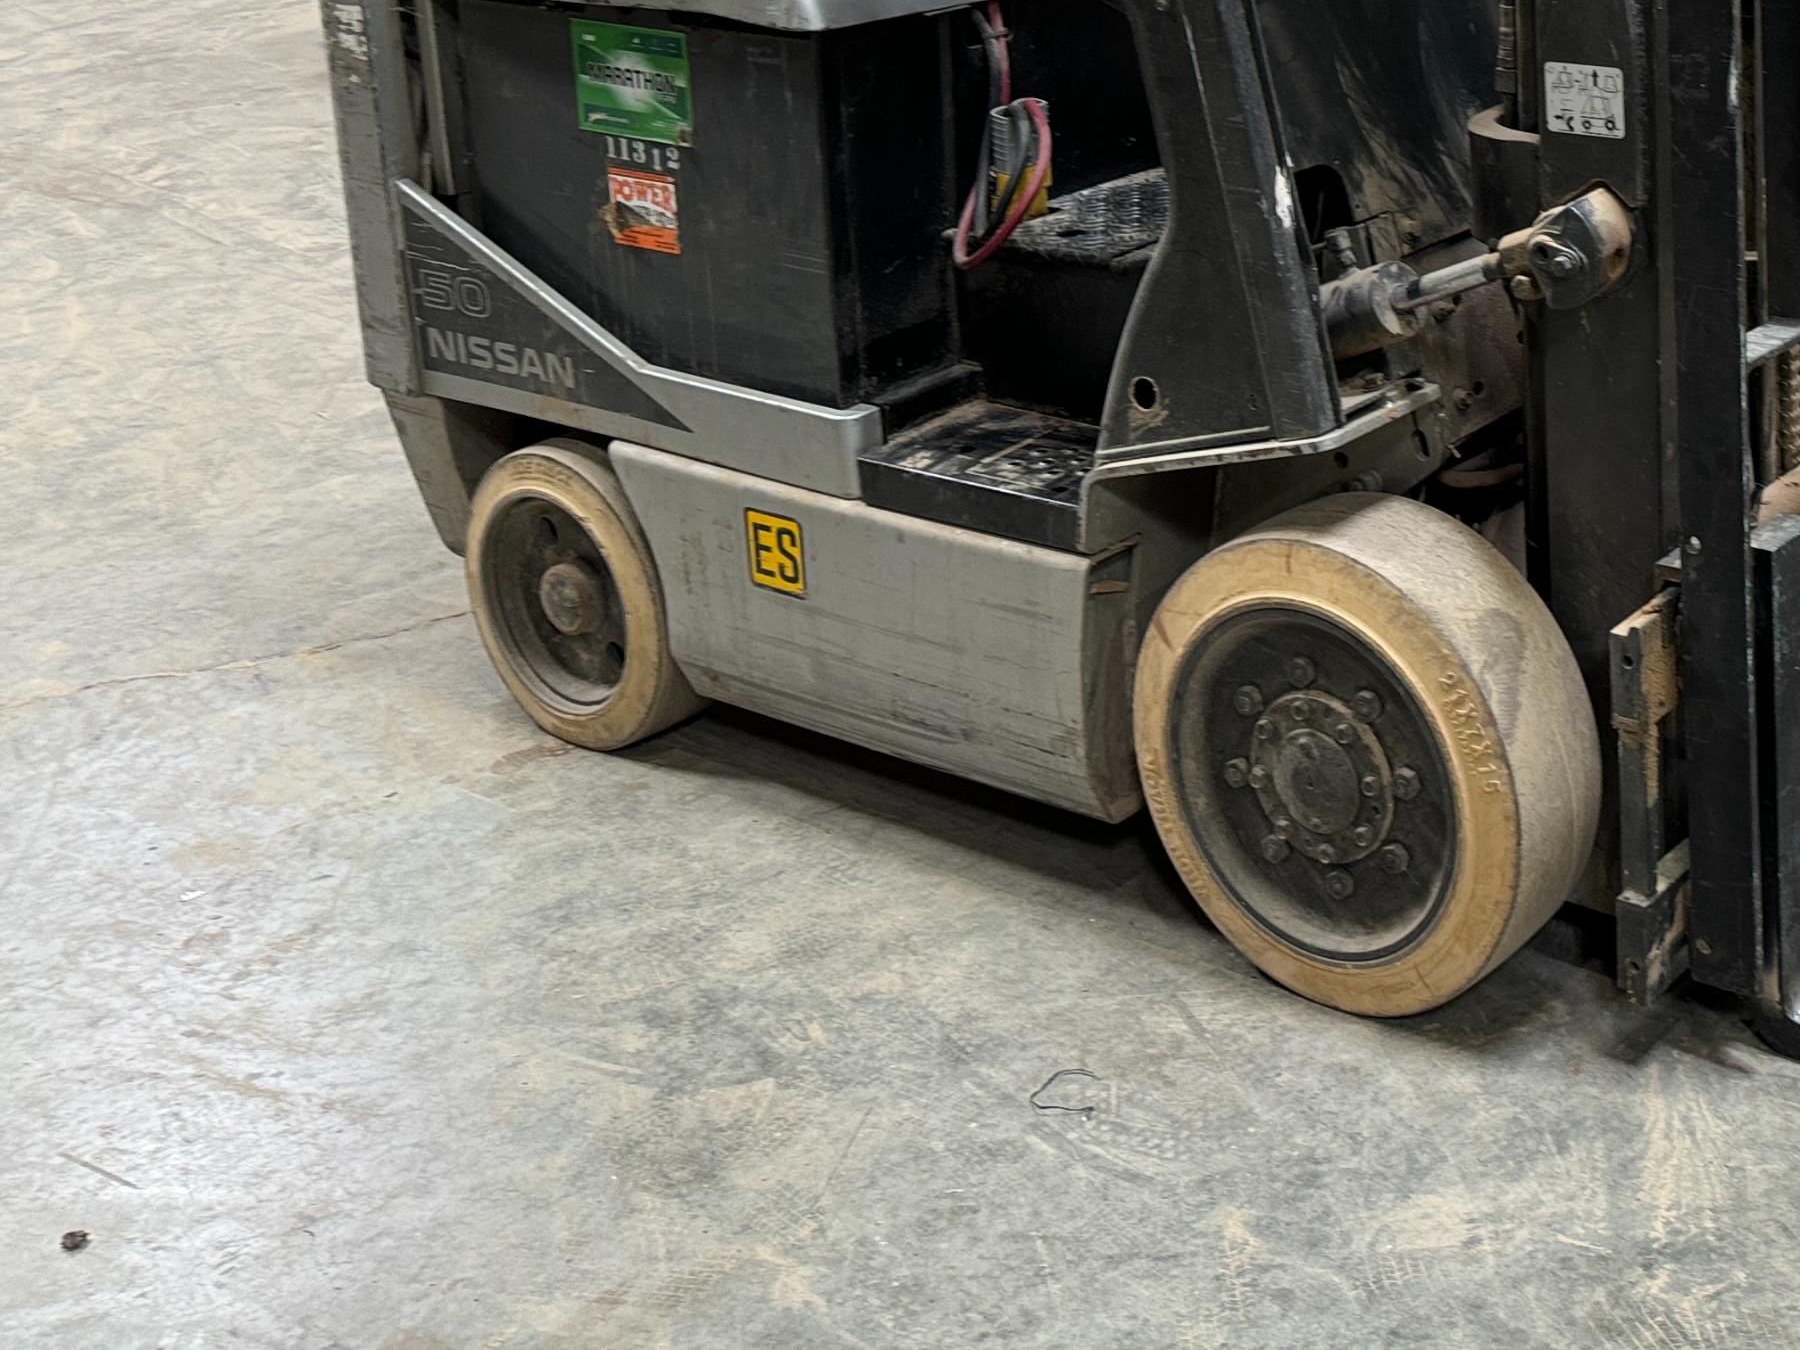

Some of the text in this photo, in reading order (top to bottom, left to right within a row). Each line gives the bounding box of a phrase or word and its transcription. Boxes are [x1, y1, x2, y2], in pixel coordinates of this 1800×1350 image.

[586, 62, 676, 93] MARATHON
[427, 327, 575, 389] NISSAN
[753, 521, 799, 584] ES
